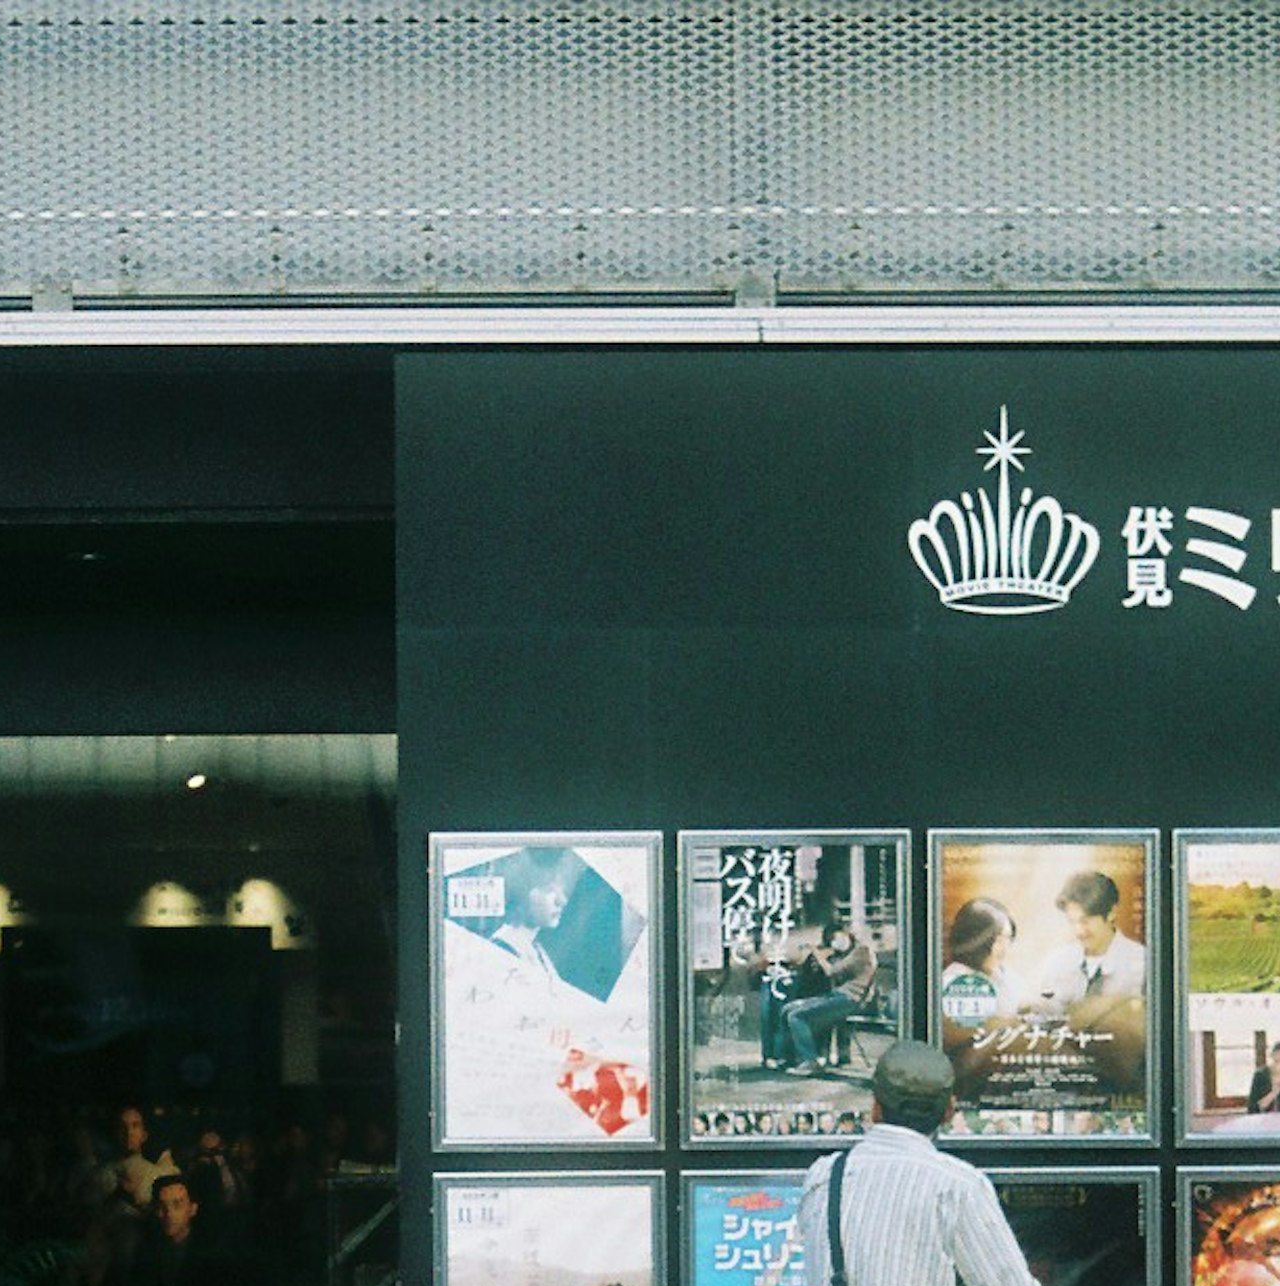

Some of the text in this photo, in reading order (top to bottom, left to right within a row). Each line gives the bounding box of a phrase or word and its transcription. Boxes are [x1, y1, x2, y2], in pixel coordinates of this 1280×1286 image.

[972, 1024, 1114, 1050] シグナチャー
